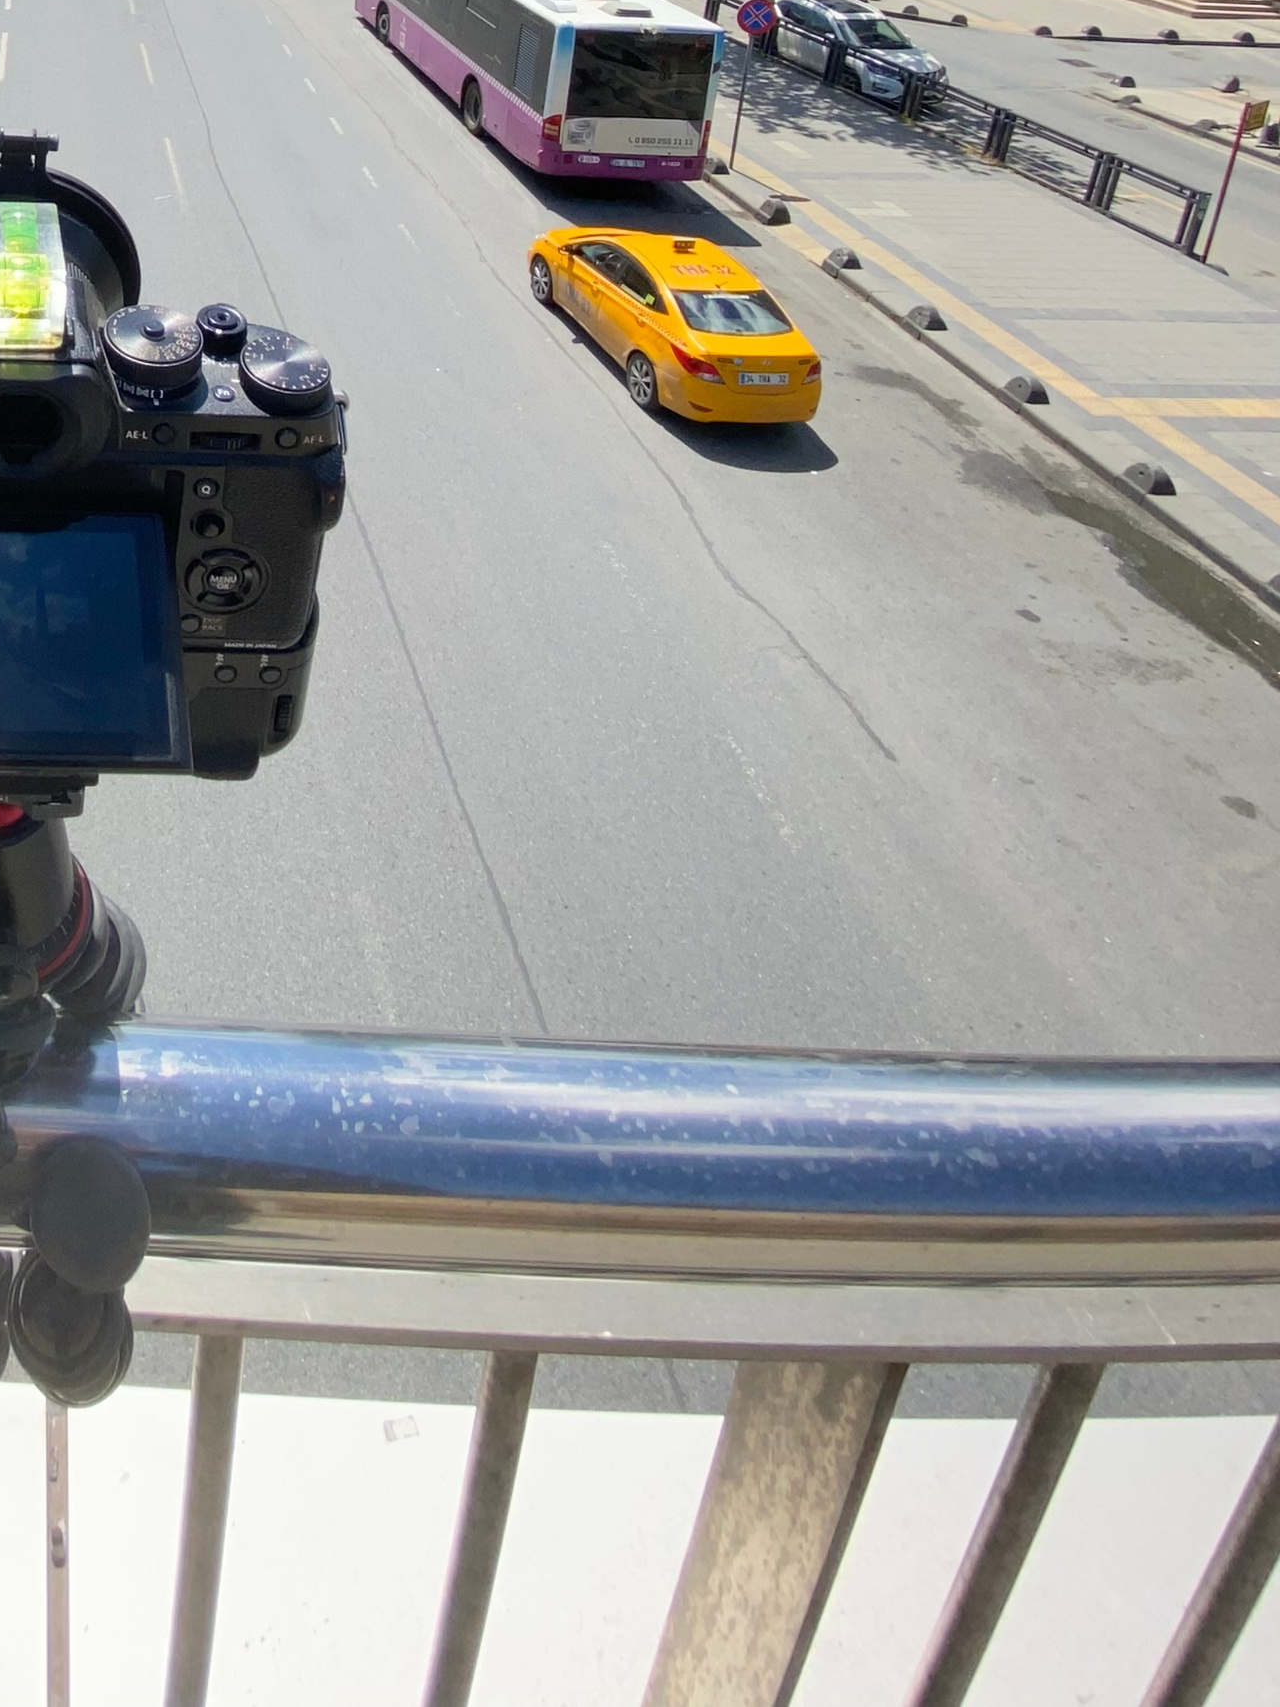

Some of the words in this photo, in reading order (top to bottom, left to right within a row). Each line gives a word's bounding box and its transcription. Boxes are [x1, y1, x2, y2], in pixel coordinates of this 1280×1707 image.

[670, 264, 712, 275] THA
[710, 264, 736, 275] 32
[217, 388, 230, 396] Fn
[125, 430, 148, 439] AE-L
[303, 435, 324, 445] AF-L
[201, 485, 211, 494] Q
[210, 574, 237, 585] MENU
